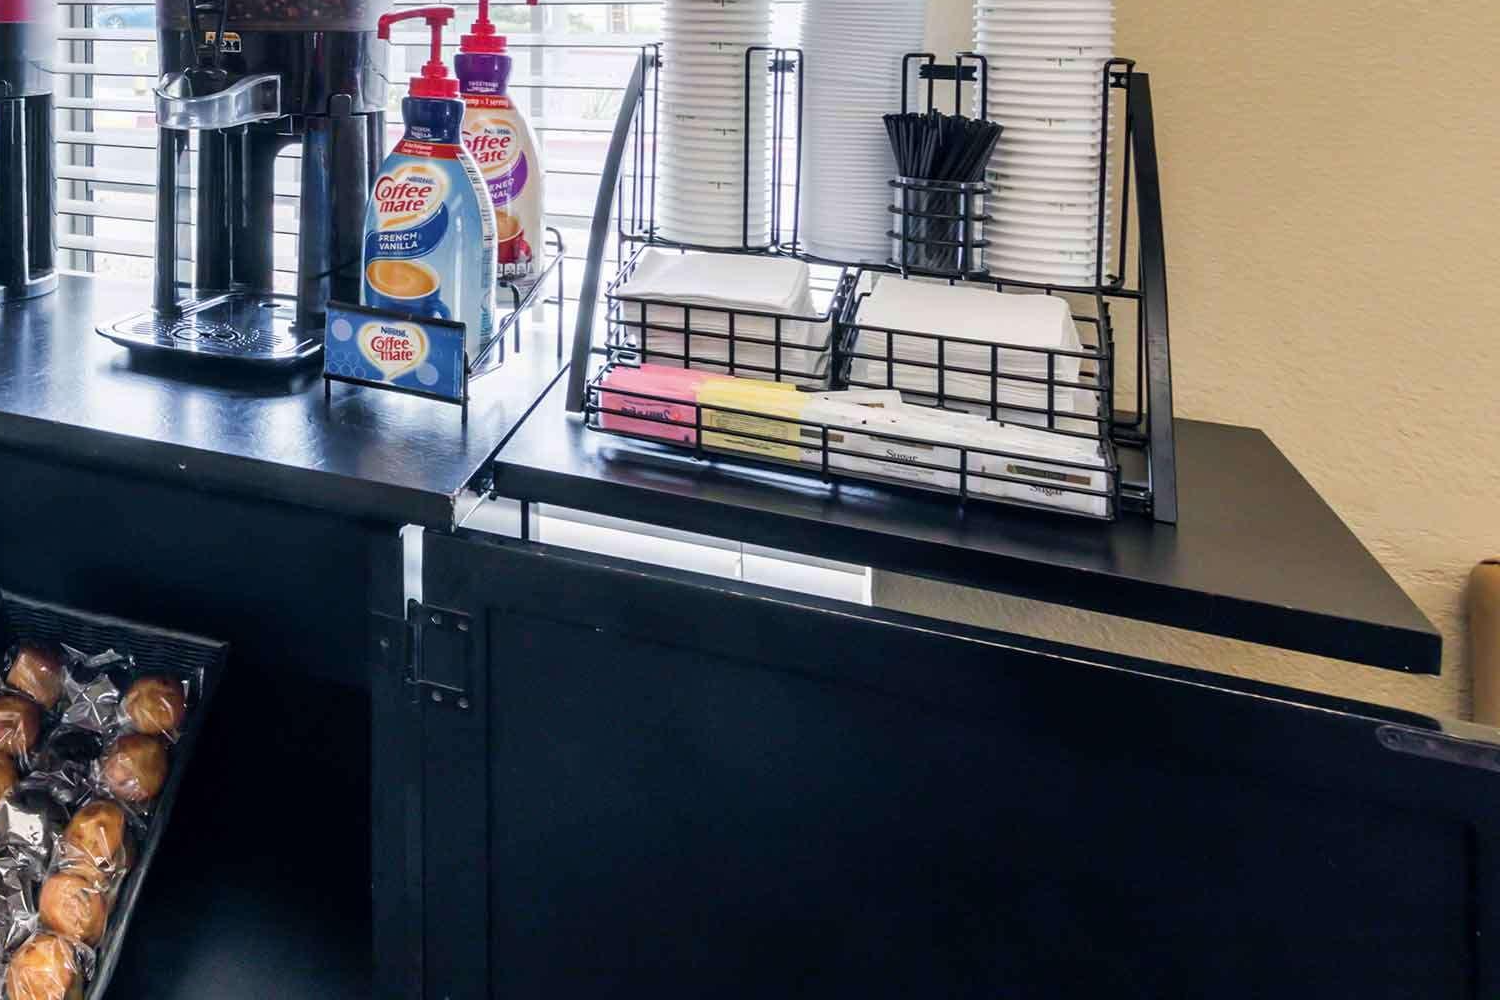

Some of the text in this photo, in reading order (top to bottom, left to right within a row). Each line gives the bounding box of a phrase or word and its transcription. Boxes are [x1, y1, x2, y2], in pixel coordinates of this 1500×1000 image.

[375, 176, 432, 201] Coffee
[380, 199, 424, 213] mate
[379, 232, 417, 241] FRENCH
[379, 240, 418, 250] VANILLA
[381, 350, 413, 360] mate
